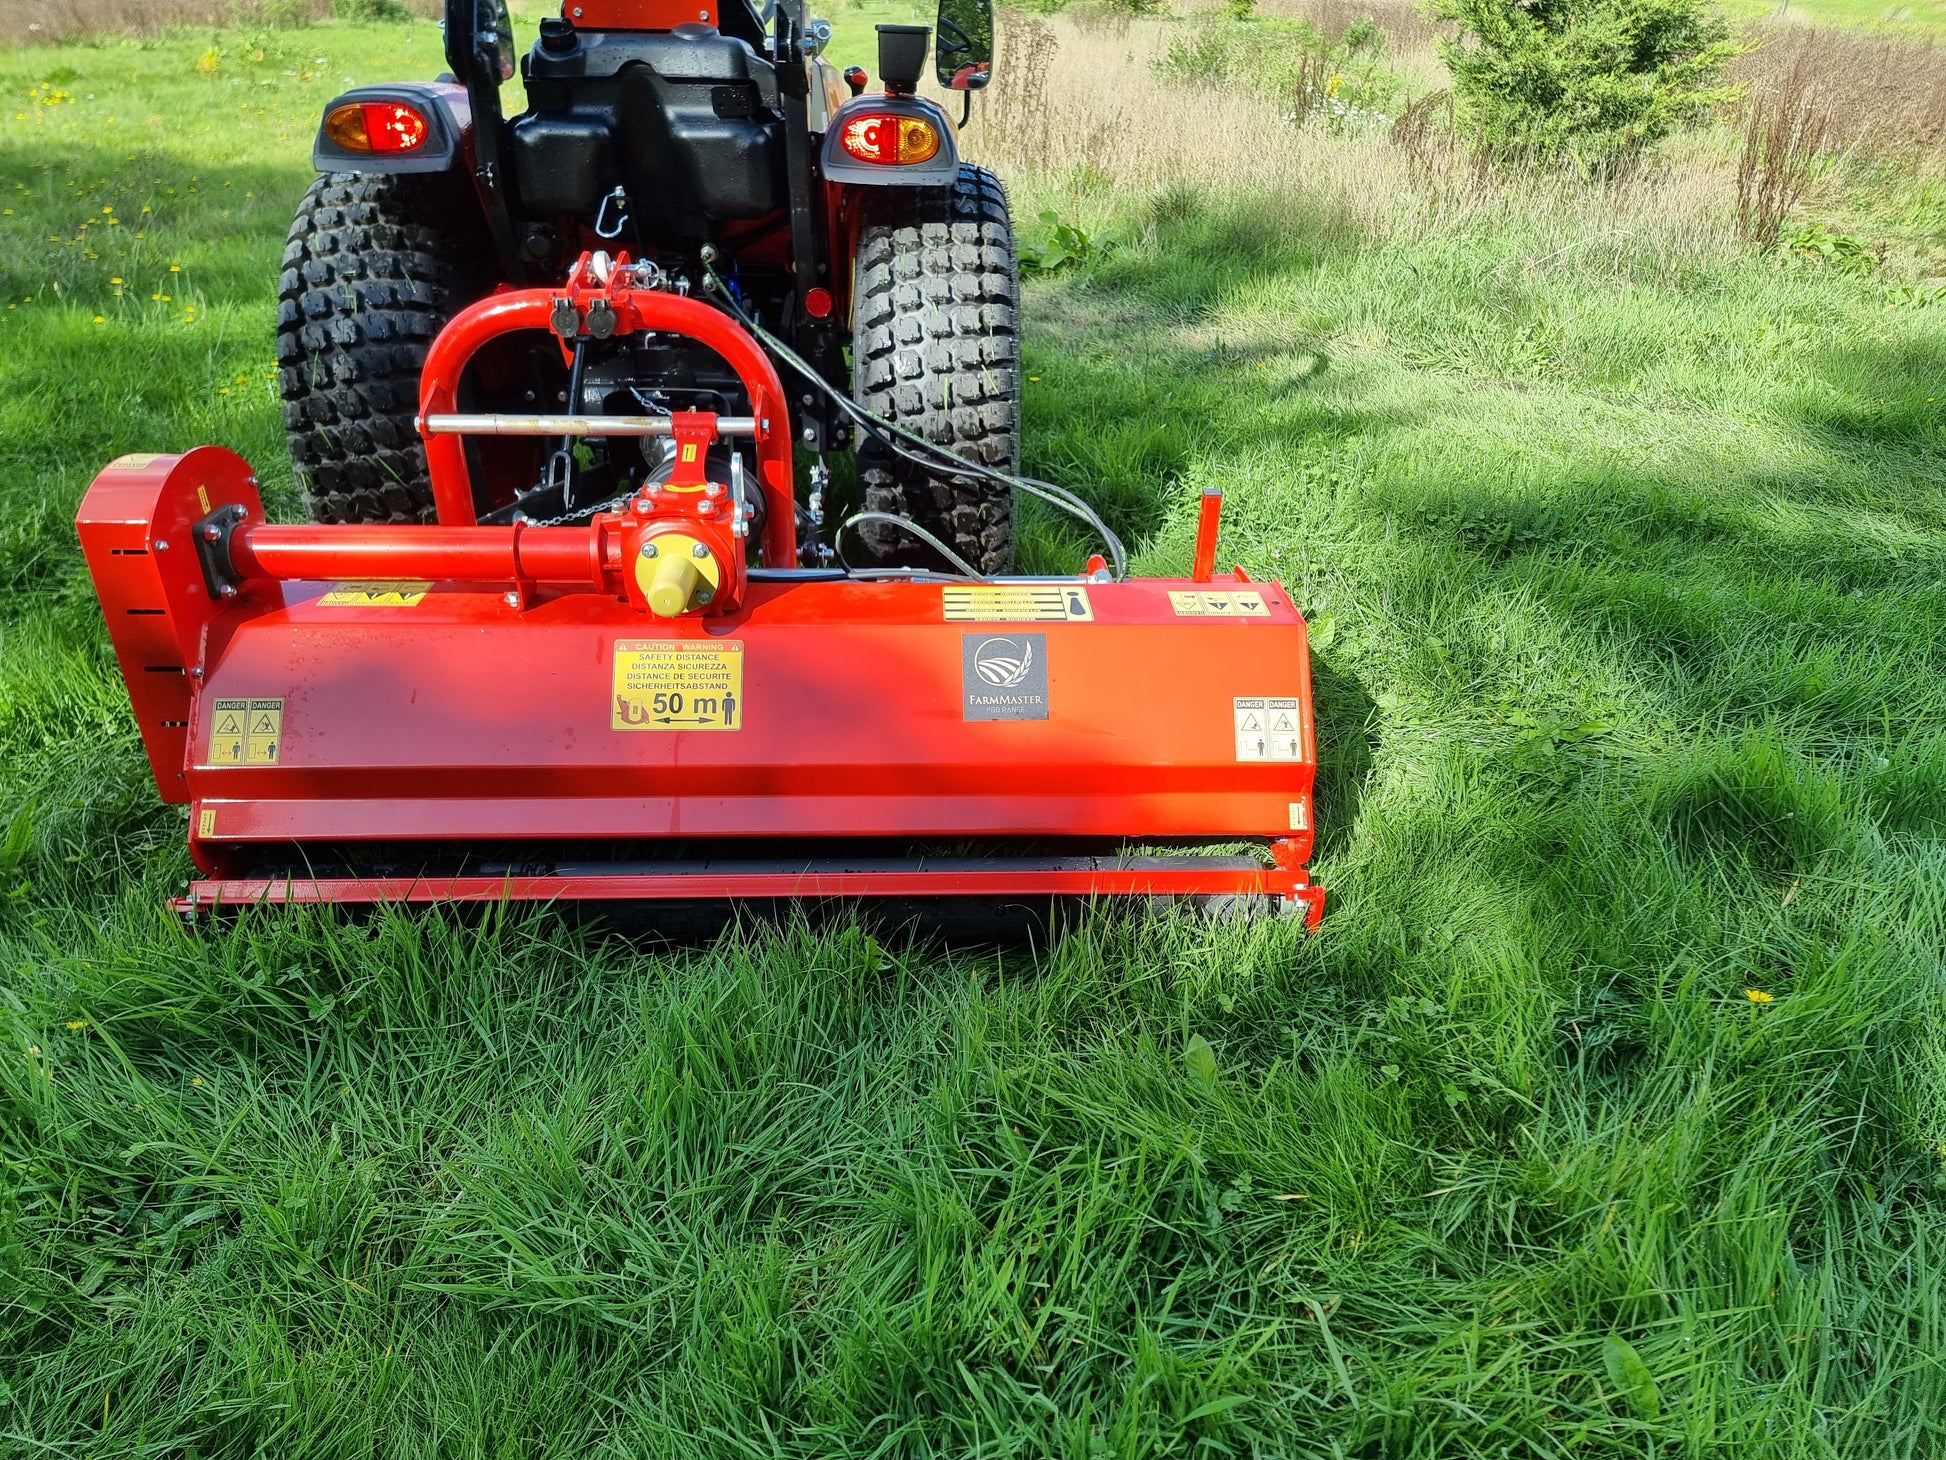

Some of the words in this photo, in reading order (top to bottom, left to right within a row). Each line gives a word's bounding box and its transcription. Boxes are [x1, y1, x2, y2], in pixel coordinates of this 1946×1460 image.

[635, 643, 675, 651] CAUTION
[682, 643, 724, 651] WARNING
[639, 653, 674, 661] SAFETY
[676, 653, 720, 661] DISTANCE
[627, 672, 671, 680] DISTANCE
[673, 672, 686, 680] DE
[688, 672, 732, 680] SECURITE
[627, 682, 728, 690] SICHERHEITSABSTAND
[652, 692, 684, 714] 50
[693, 697, 717, 714] m
[969, 695, 1042, 705] FARMMASTER
[1237, 700, 1264, 708] DANGER
[1269, 700, 1296, 708] DANGER
